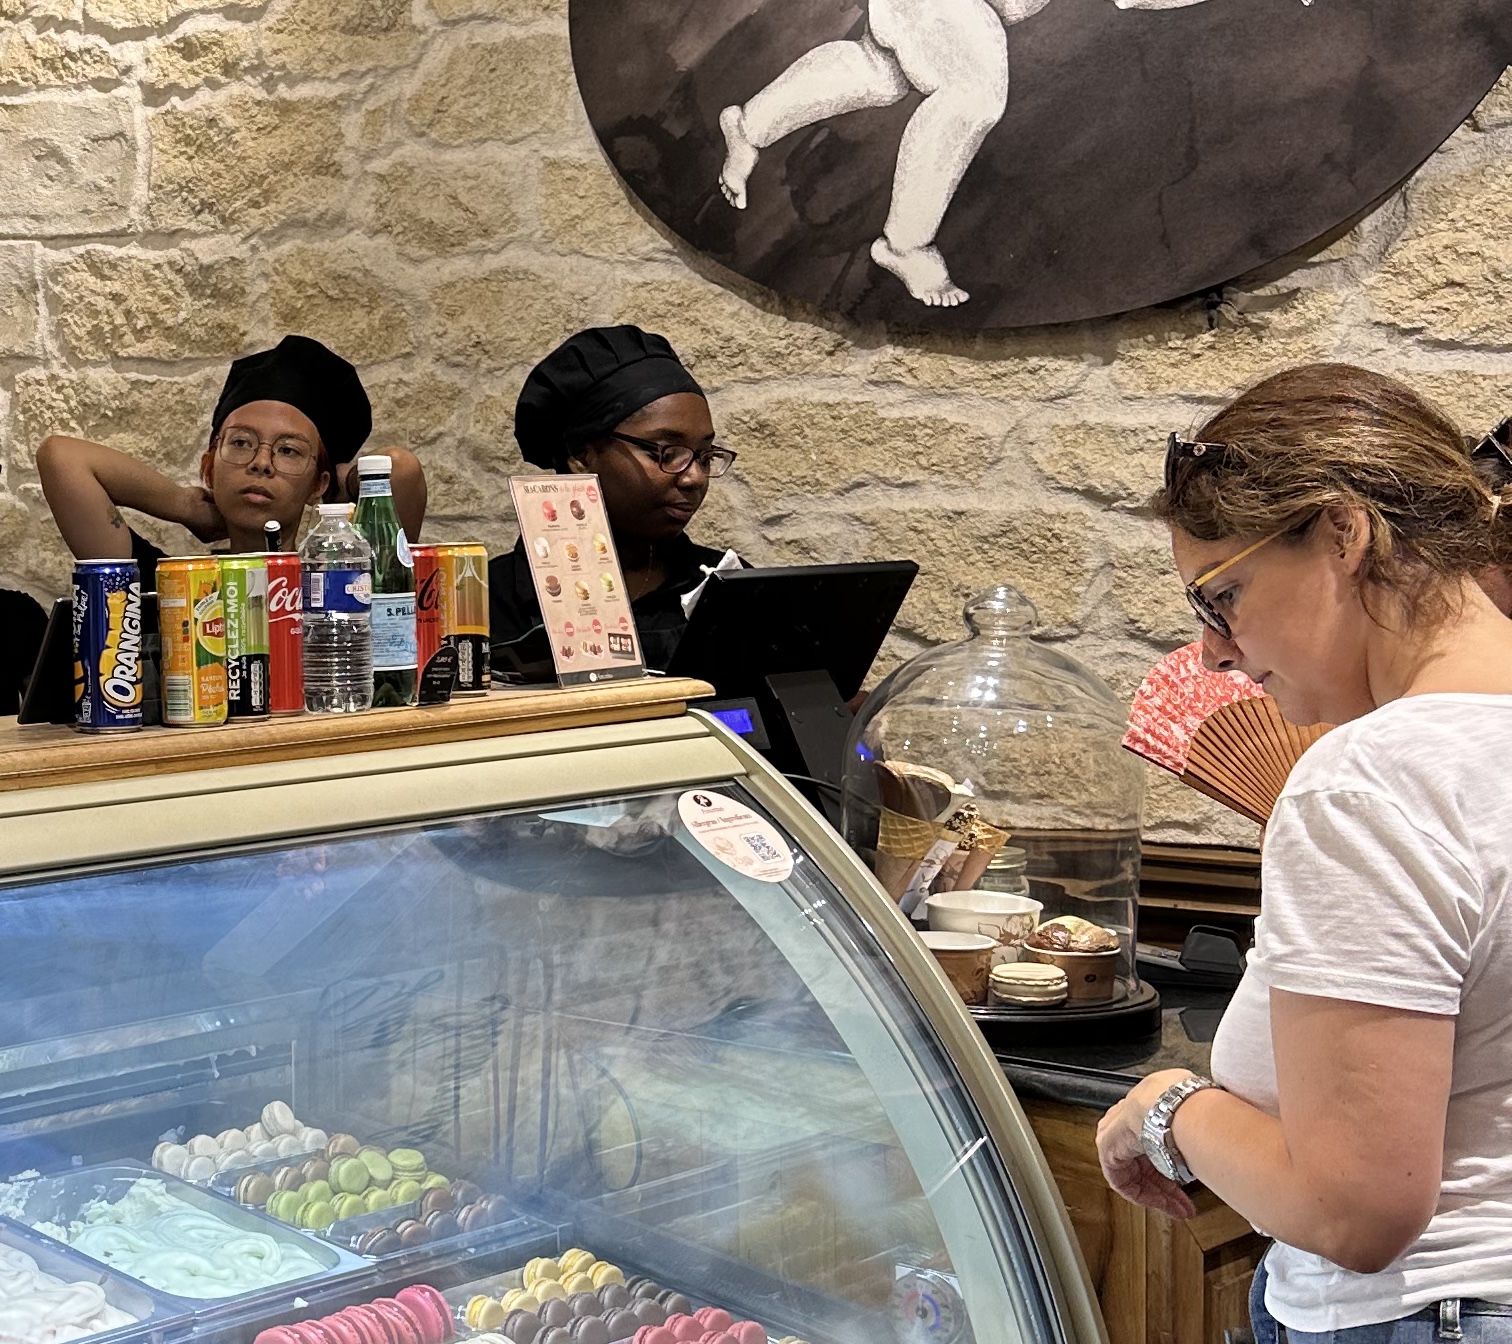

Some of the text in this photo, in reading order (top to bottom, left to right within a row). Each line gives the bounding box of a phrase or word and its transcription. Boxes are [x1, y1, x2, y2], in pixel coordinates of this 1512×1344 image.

[524, 484, 559, 494] MACARONS
[104, 582, 141, 703] ORANGINA
[226, 581, 241, 701] RECYCLEZ-MOI
